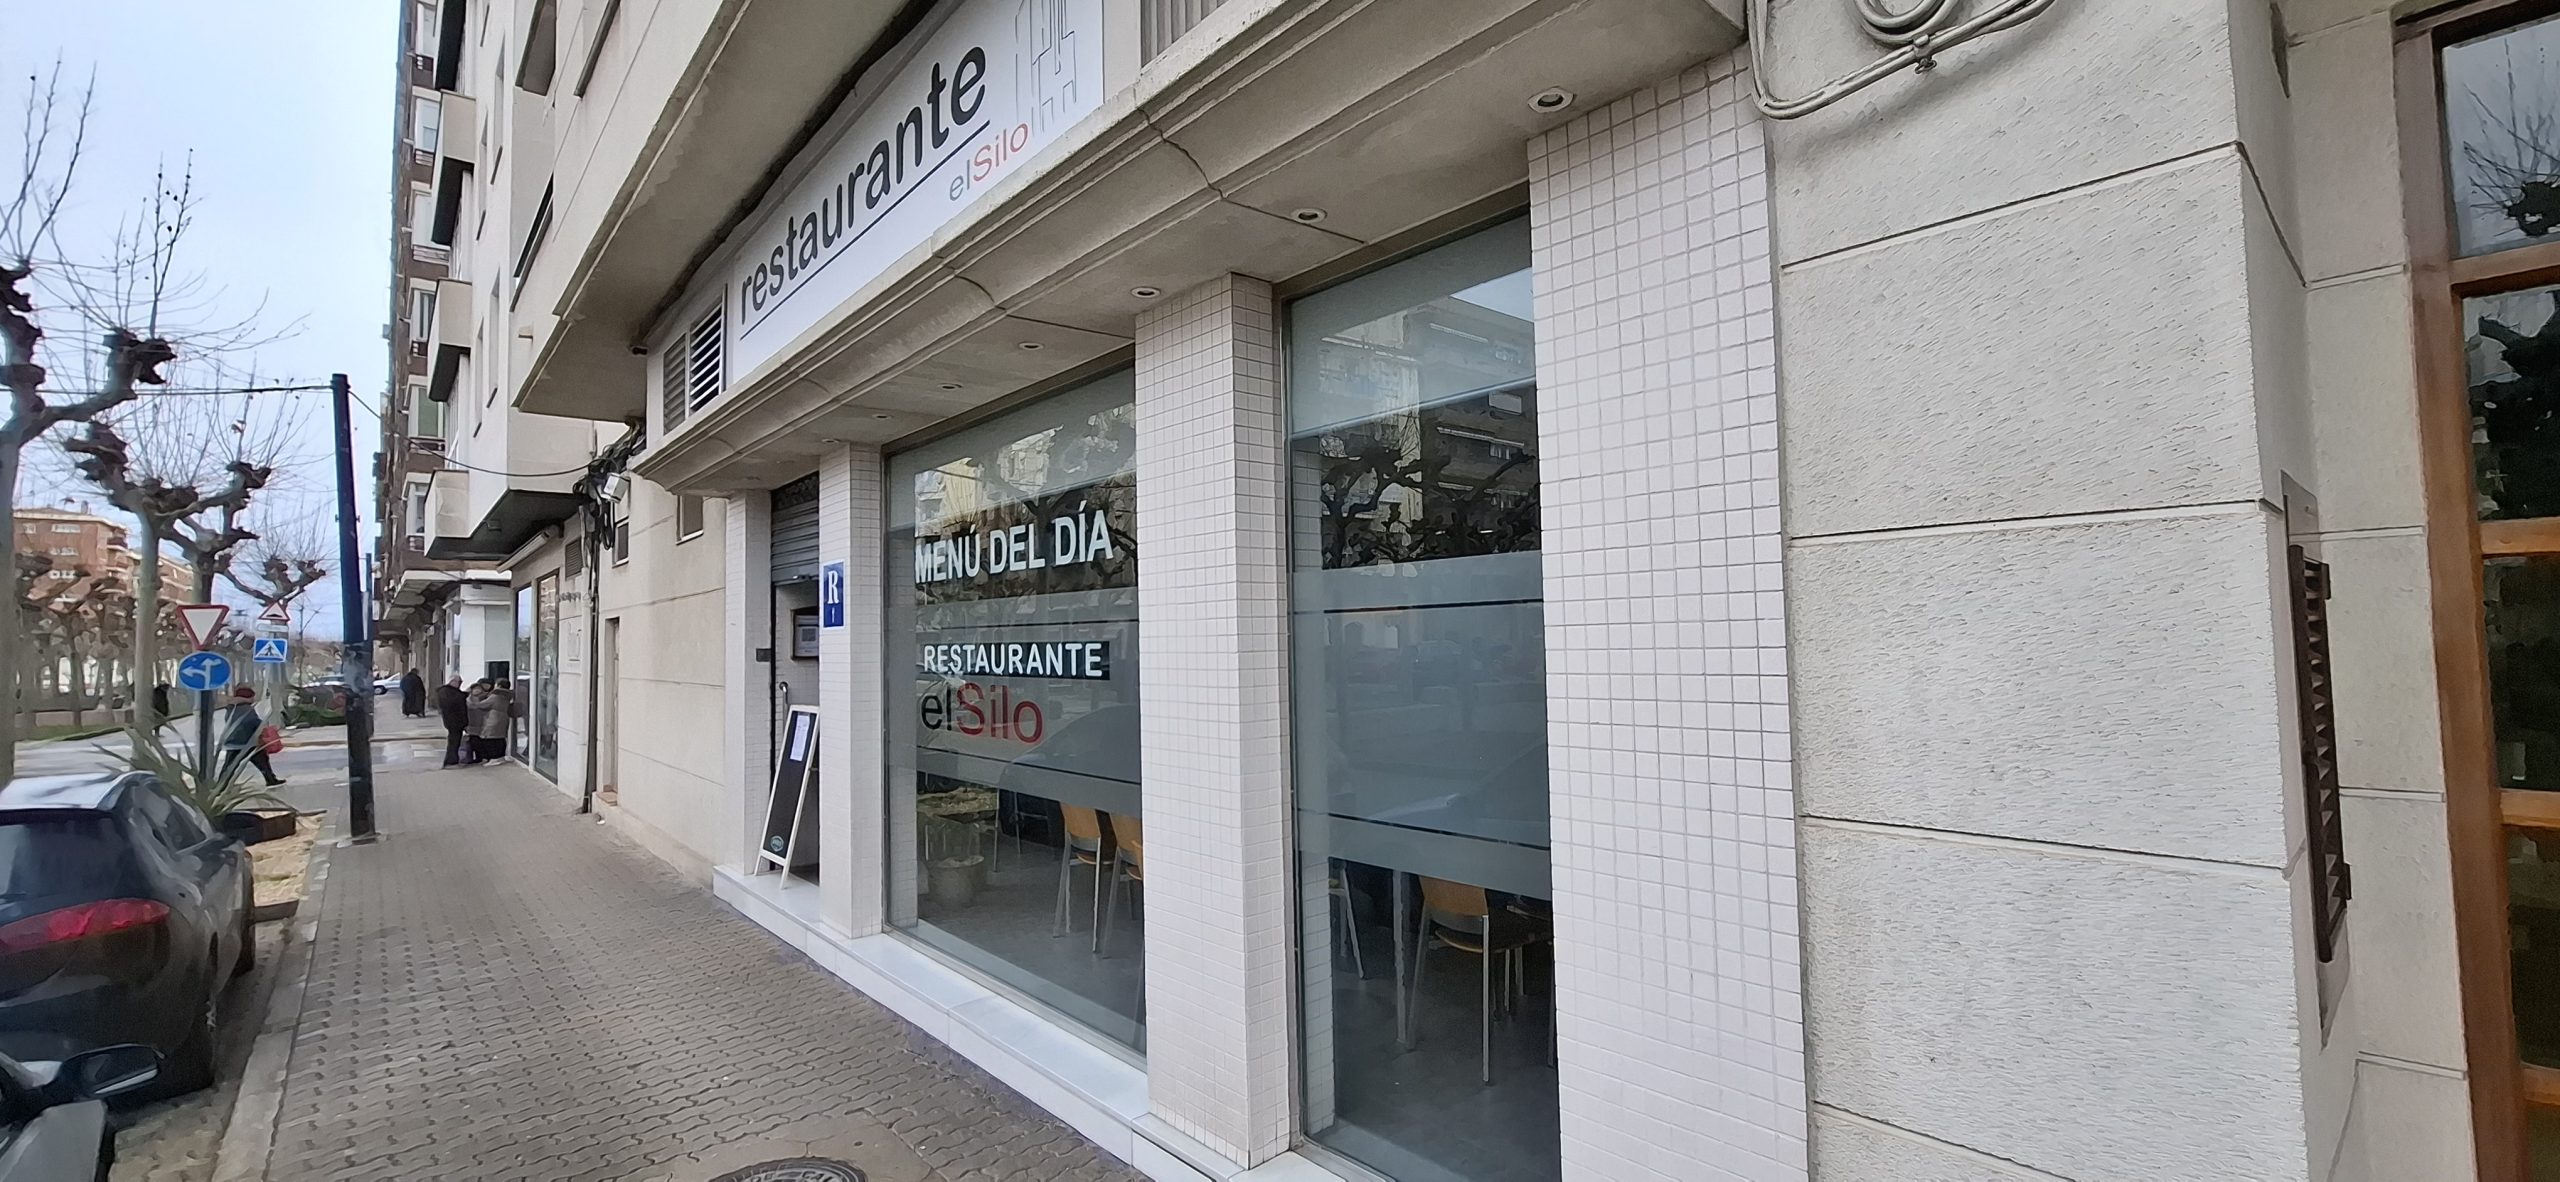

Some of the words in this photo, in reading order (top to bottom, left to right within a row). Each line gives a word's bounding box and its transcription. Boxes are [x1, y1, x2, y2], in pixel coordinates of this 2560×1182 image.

[740, 45, 987, 326] restaurante
[915, 524, 980, 584] MENÚ
[989, 523, 1046, 574] DEL
[1054, 500, 1115, 567] DÍA
[827, 570, 840, 604] R
[923, 643, 1103, 678] RESTAURANTE
